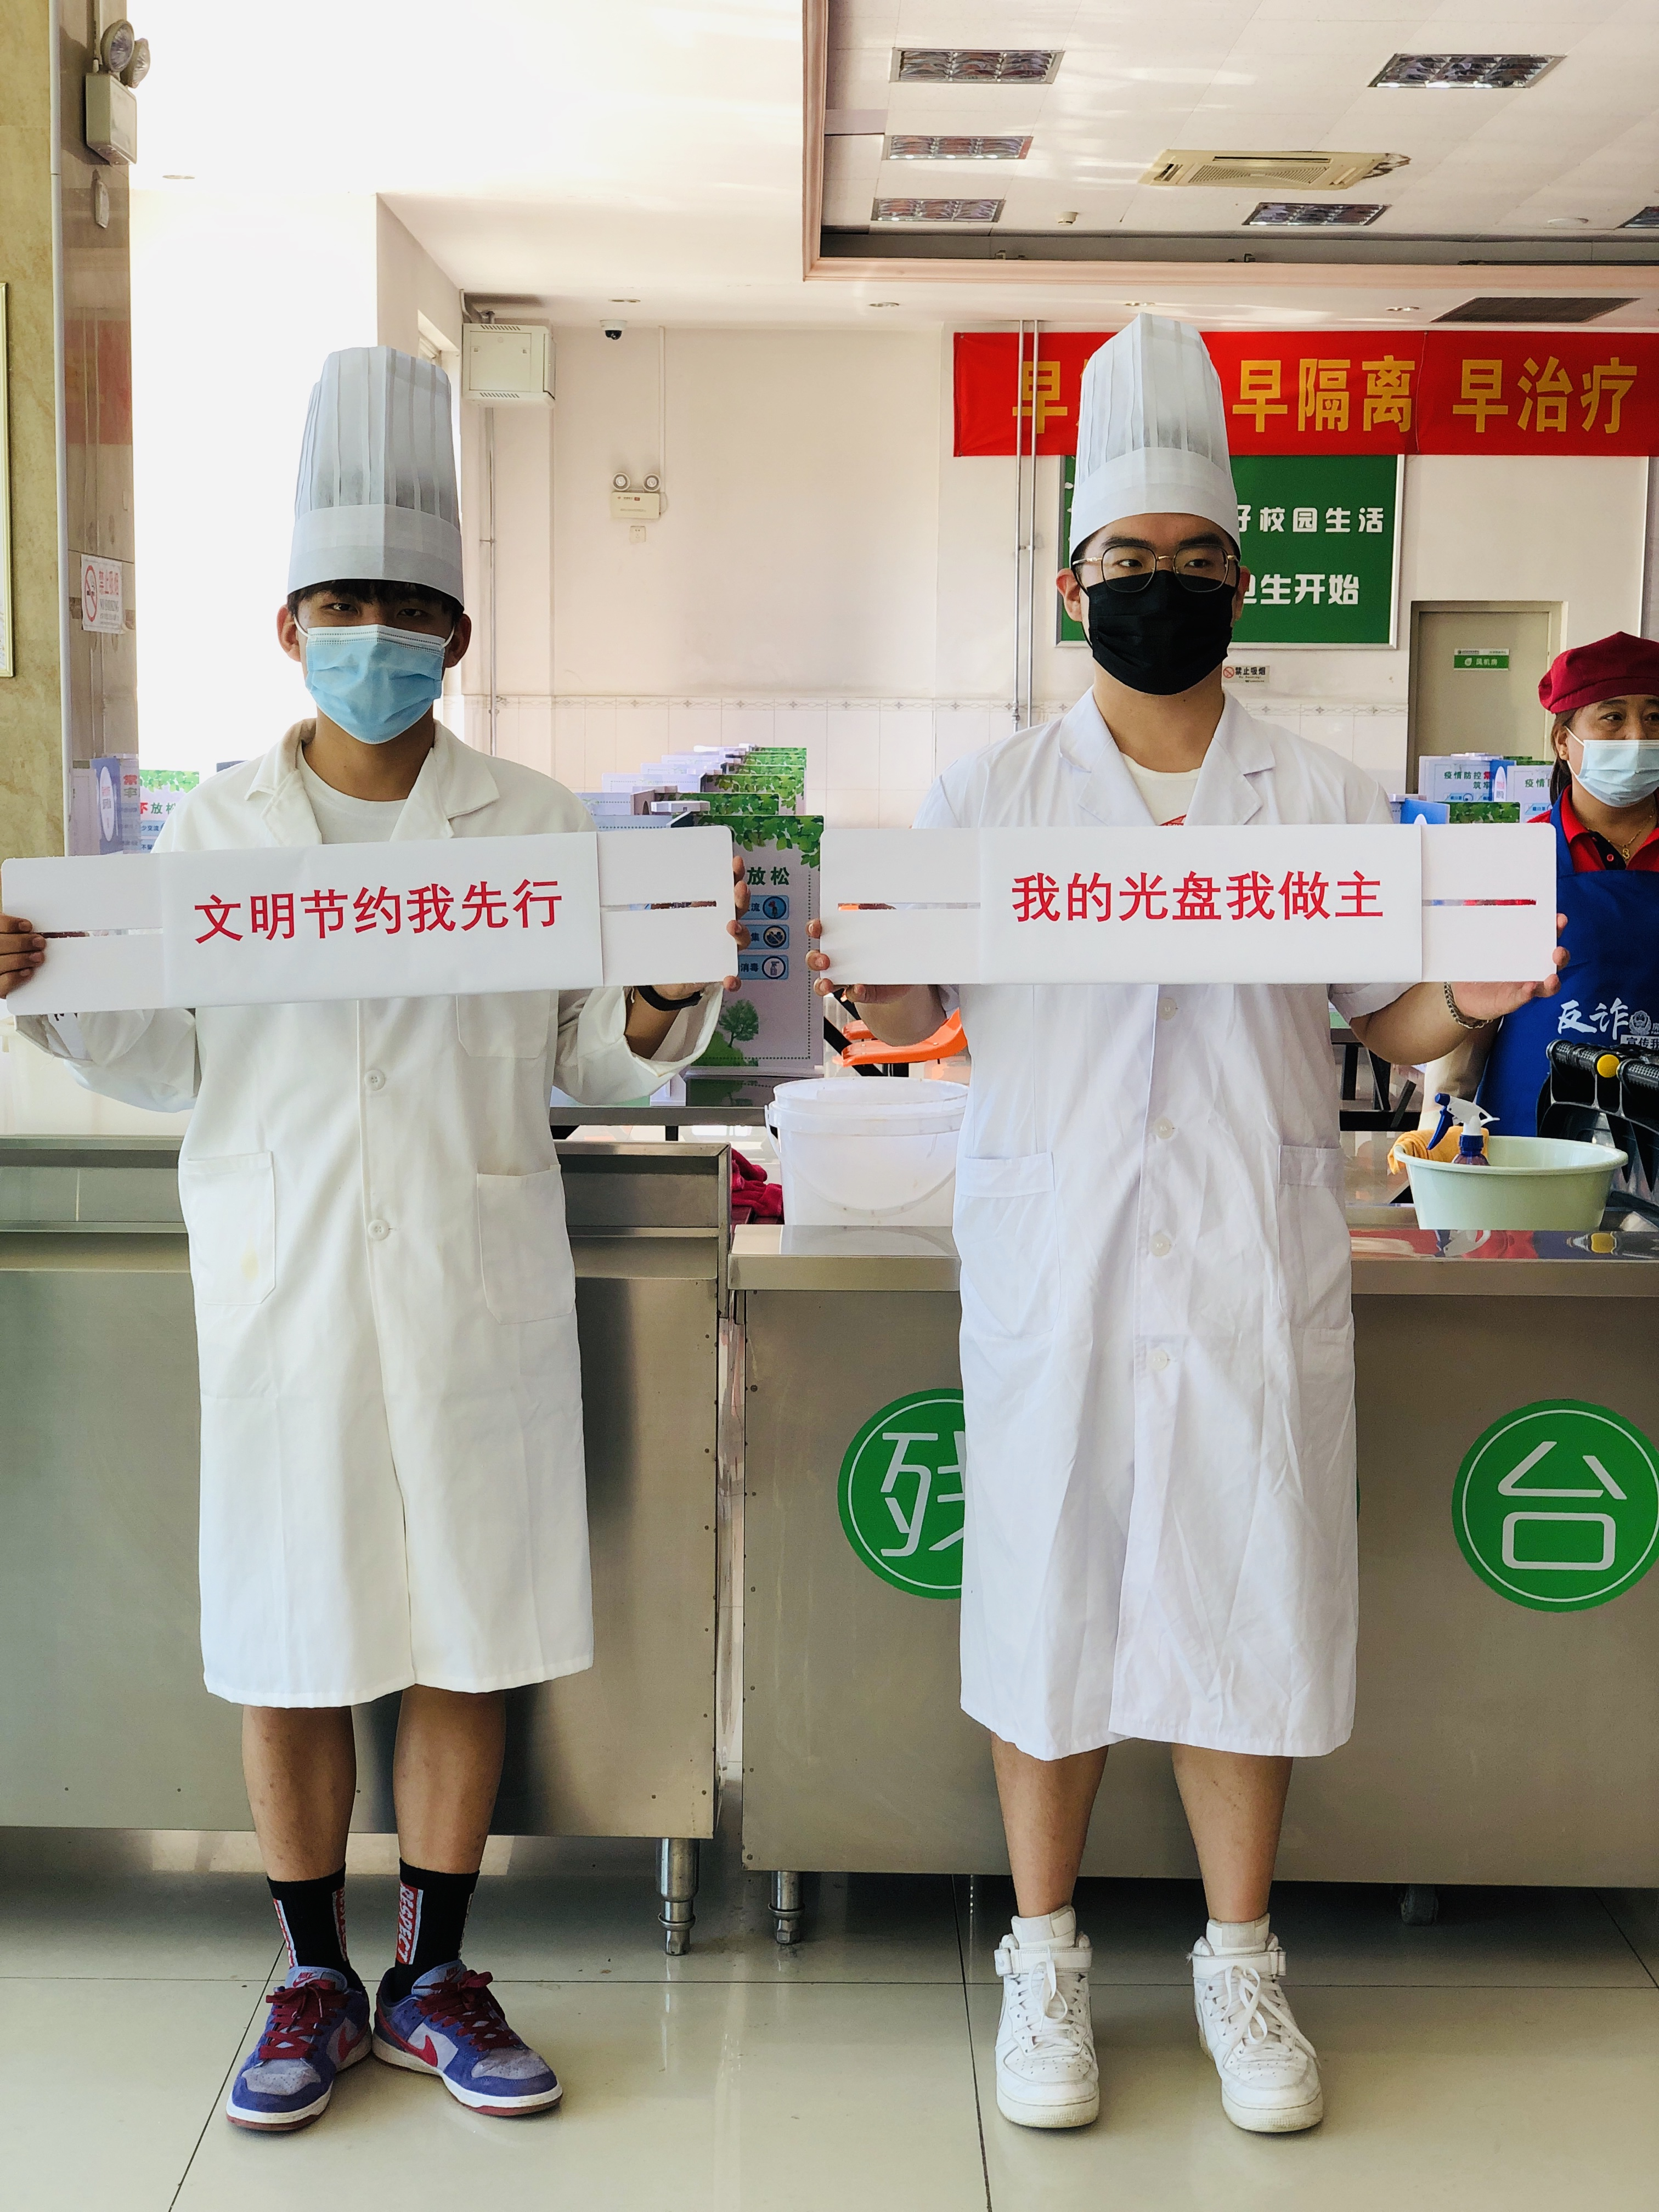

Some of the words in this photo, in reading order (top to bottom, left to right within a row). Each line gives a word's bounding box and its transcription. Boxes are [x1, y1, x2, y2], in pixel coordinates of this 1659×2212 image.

[1012, 360, 1088, 434] 早
[1232, 355, 1415, 433] 早隔离
[1452, 356, 1638, 433] 早治疗
[1235, 667, 1266, 675] 禁止吸烟
[747, 866, 790, 886] 放松
[1012, 870, 1383, 922] 我的光盘我做主
[194, 878, 562, 944] 文明节约我先行
[1558, 997, 1629, 1040] 反诈
[1498, 1441, 1627, 1571] 台
